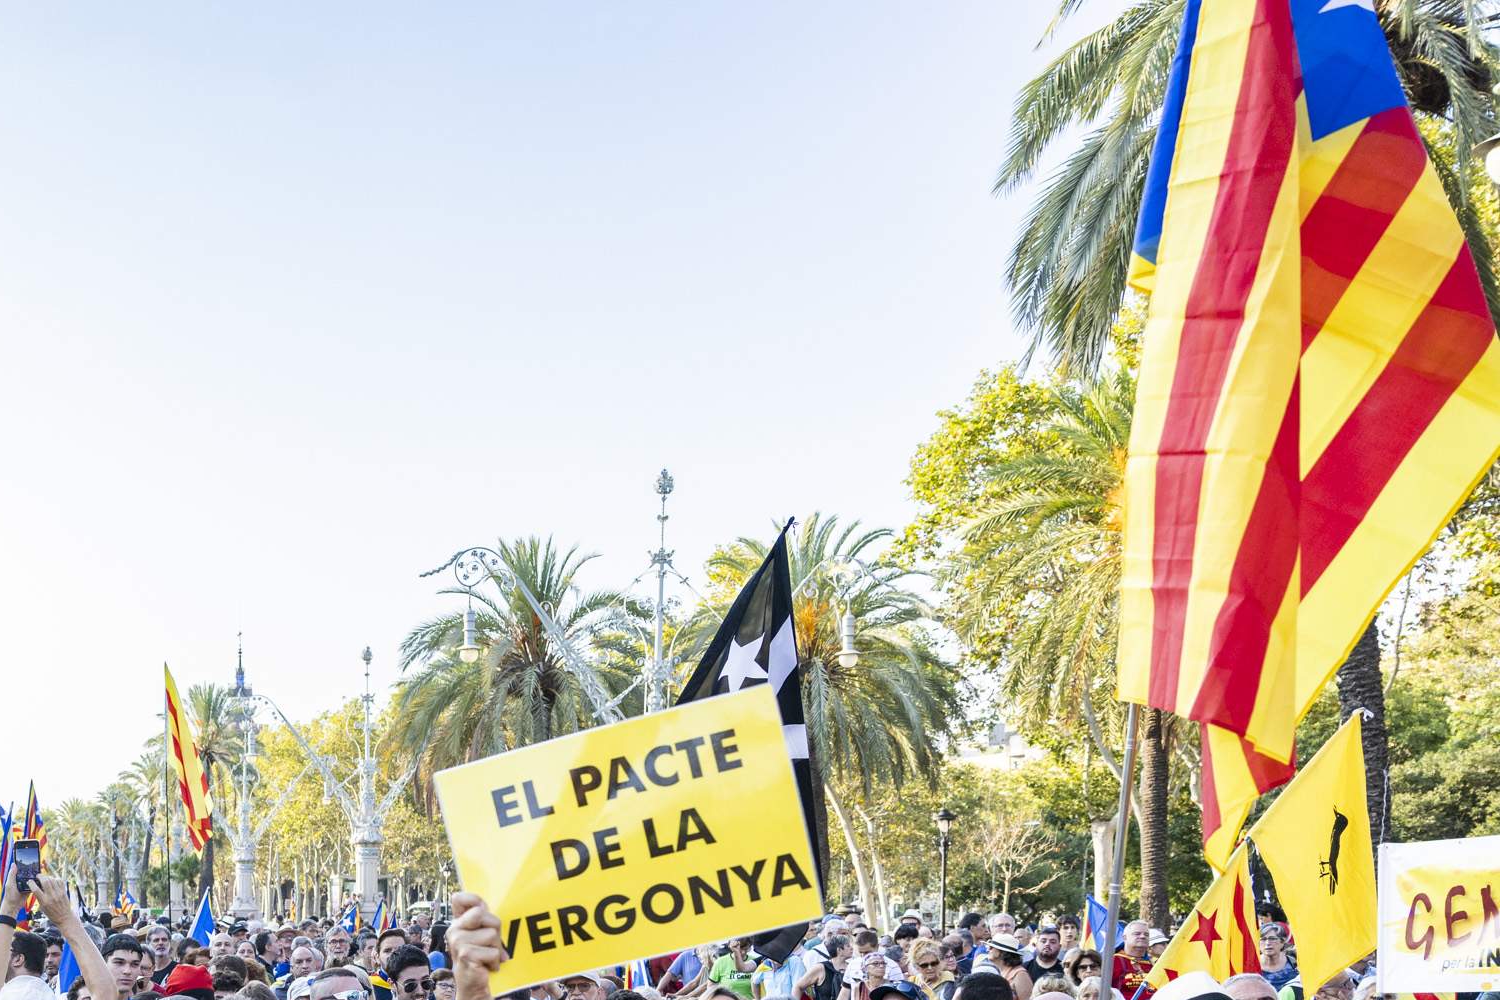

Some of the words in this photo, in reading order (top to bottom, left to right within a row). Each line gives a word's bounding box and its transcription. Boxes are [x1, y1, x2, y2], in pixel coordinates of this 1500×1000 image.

[491, 780, 555, 829] EL
[569, 728, 744, 808] PACTE
[550, 827, 626, 881] DE
[642, 807, 717, 859] LA
[500, 852, 813, 960] VERGONYA
